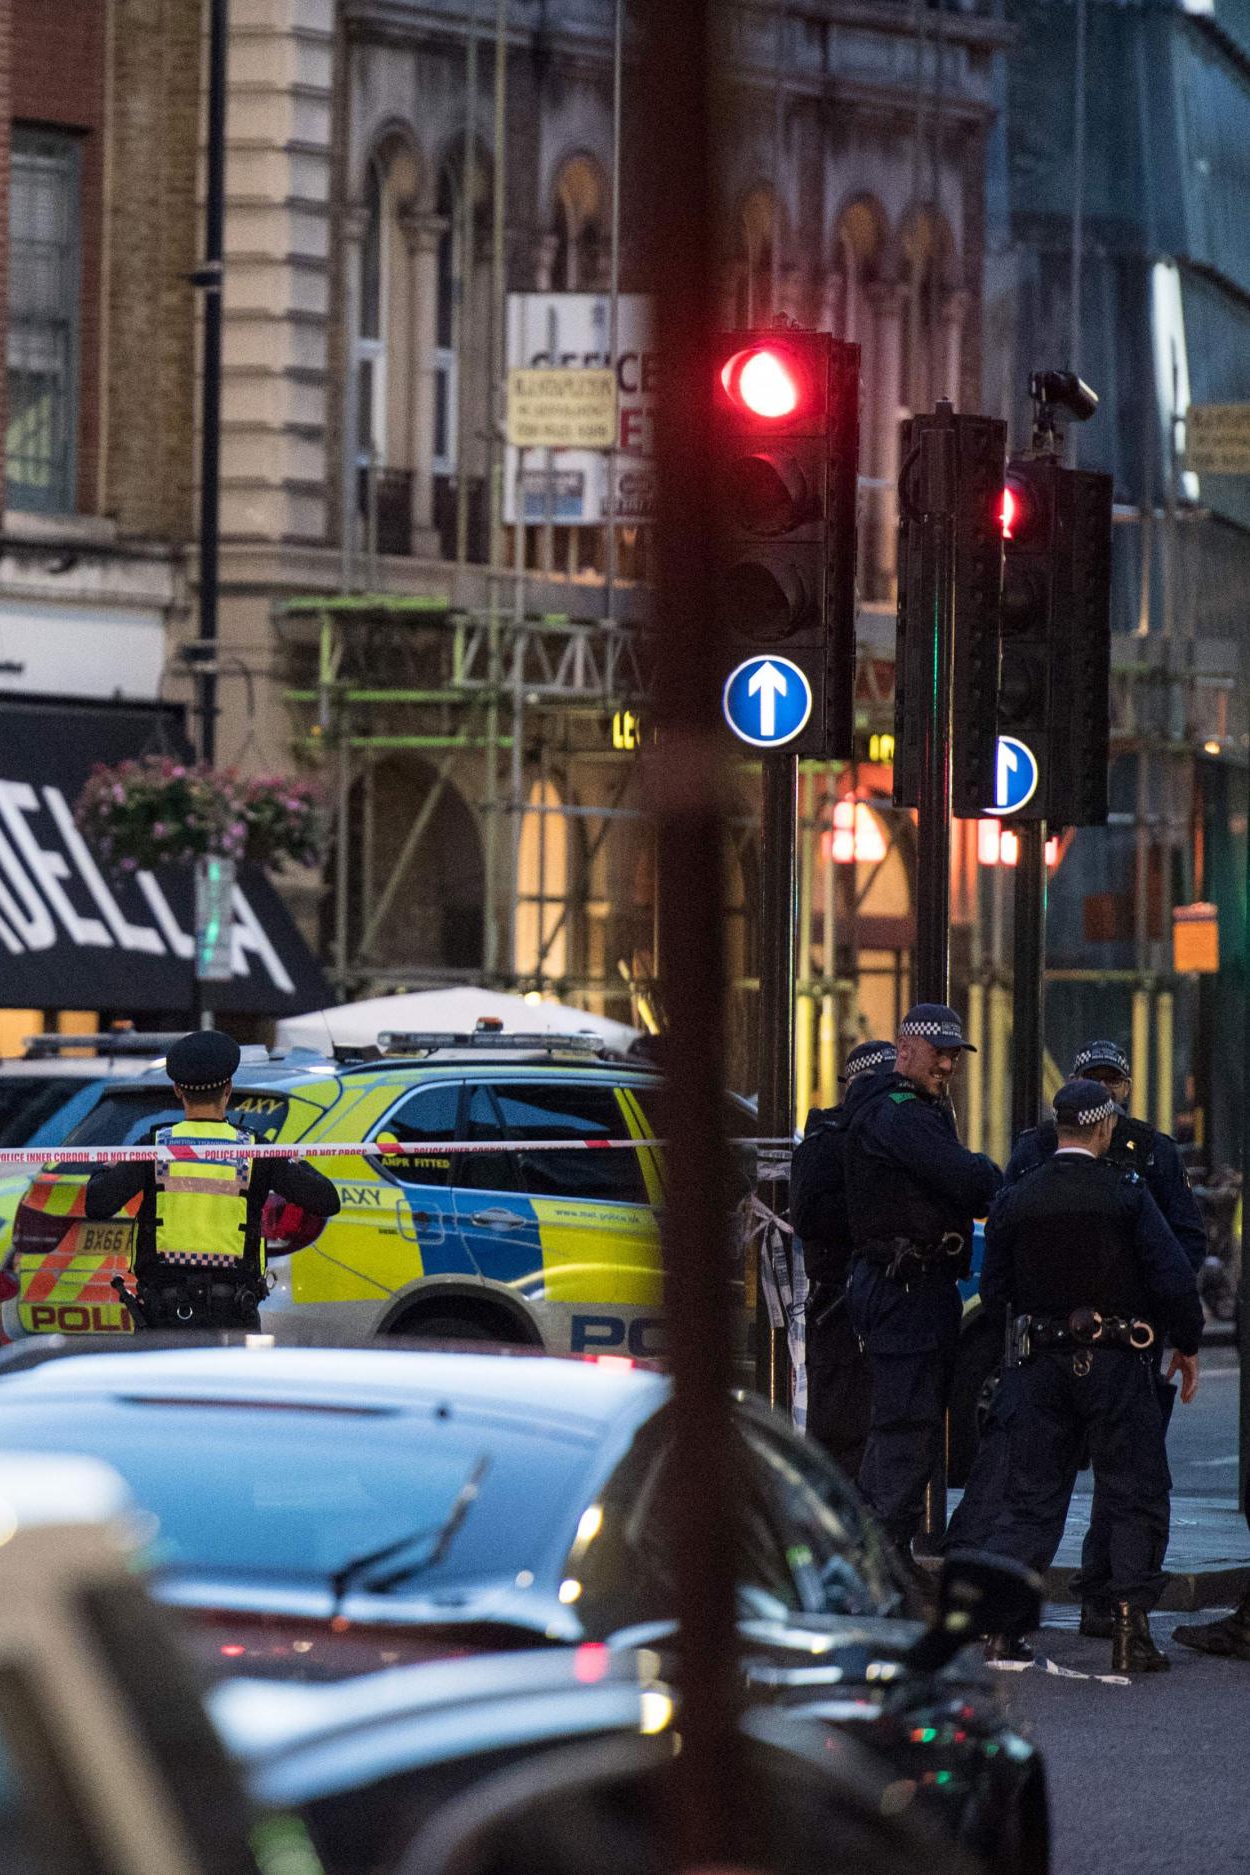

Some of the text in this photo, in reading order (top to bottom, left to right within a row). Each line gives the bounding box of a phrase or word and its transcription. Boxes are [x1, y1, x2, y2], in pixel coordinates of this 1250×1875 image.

[27, 1152, 51, 1162] INNER
[54, 1151, 90, 1162] CORDON
[96, 1151, 109, 1162] DO
[110, 1151, 127, 1161] NOT
[129, 1151, 159, 1161] CROSS
[205, 1150, 235, 1160] POLICE
[236, 1149, 262, 1159] INNER
[263, 1148, 299, 1158] CORDON
[381, 1157, 450, 1169] ANPR FITTED
[341, 1187, 381, 1206] AXY
[82, 1230, 123, 1250] BX66
[31, 1305, 132, 1331] POLI
